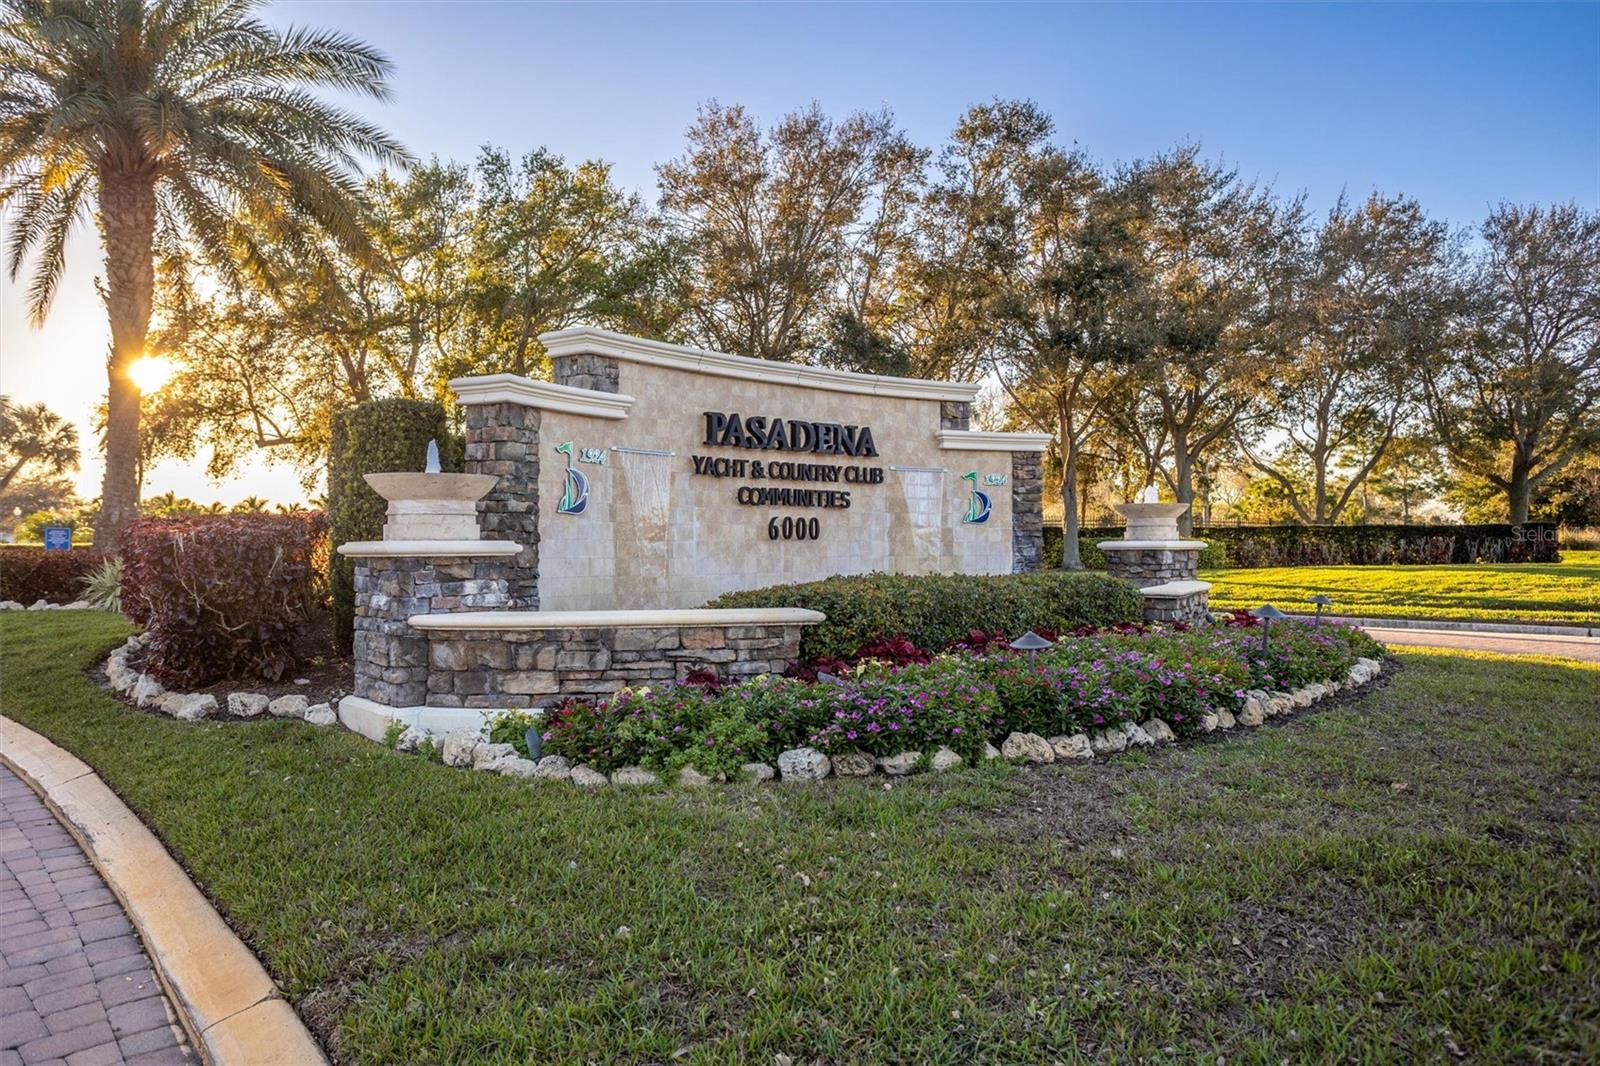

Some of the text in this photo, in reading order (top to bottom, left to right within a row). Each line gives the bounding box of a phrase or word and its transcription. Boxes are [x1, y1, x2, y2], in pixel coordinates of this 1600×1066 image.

[703, 411, 880, 457] PASADENA
[692, 455, 884, 484] YACHT & COUNTRY CLUB
[737, 486, 851, 509] COMMUNITIES
[768, 516, 820, 541] 6000
